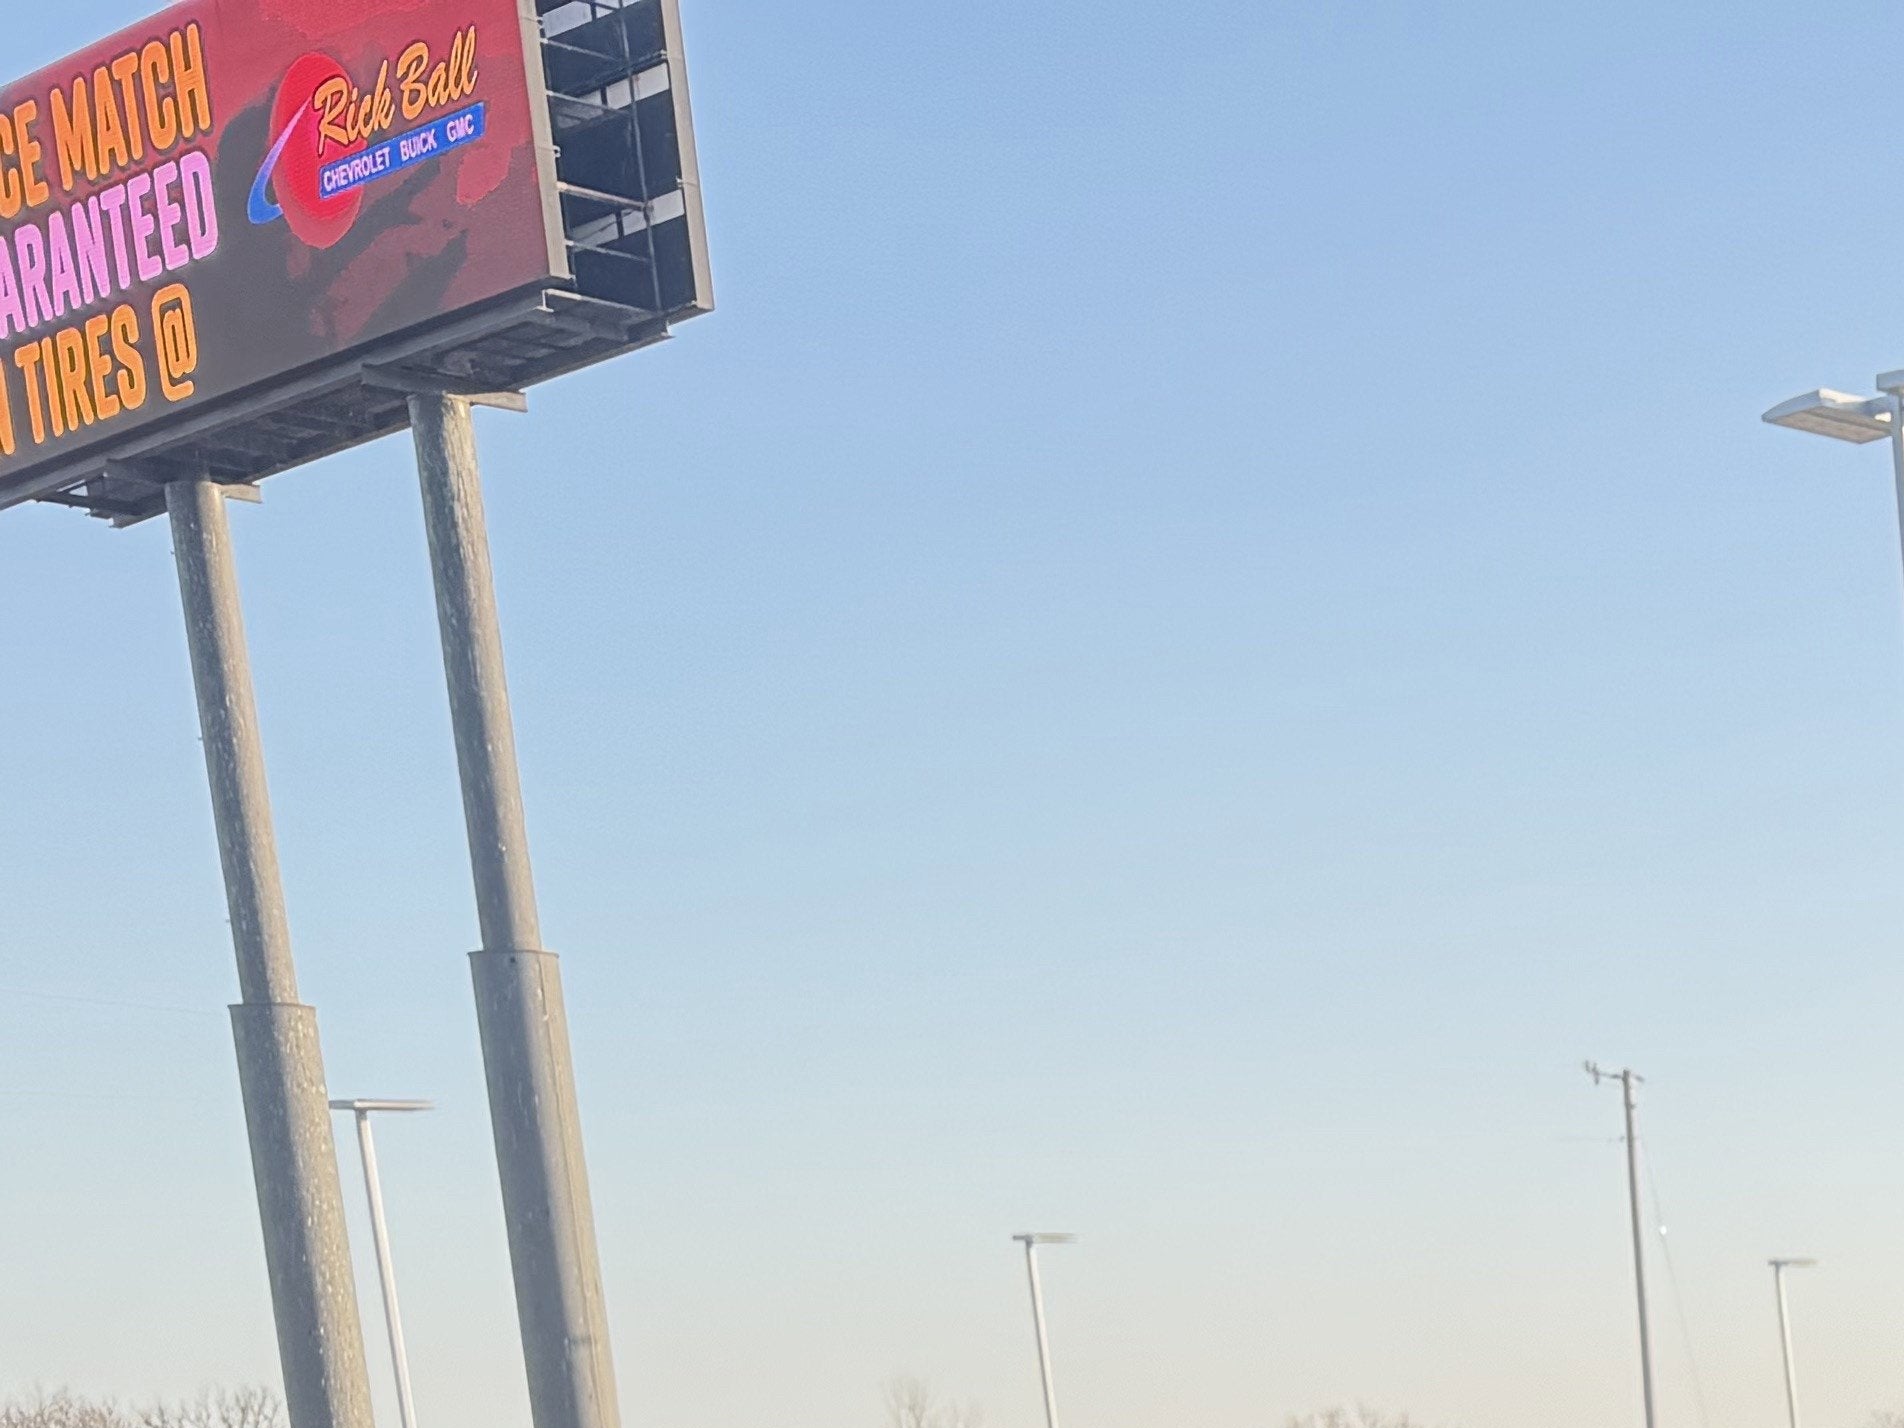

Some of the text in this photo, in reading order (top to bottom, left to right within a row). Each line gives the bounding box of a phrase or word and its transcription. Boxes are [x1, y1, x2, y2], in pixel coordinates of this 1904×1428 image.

[50, 23, 210, 191] MATCH
[313, 25, 478, 155] Rick Ball
[323, 114, 475, 192] CHEVROLET BUICK GMC
[15, 304, 146, 444] TIRES
[151, 283, 197, 402] @
